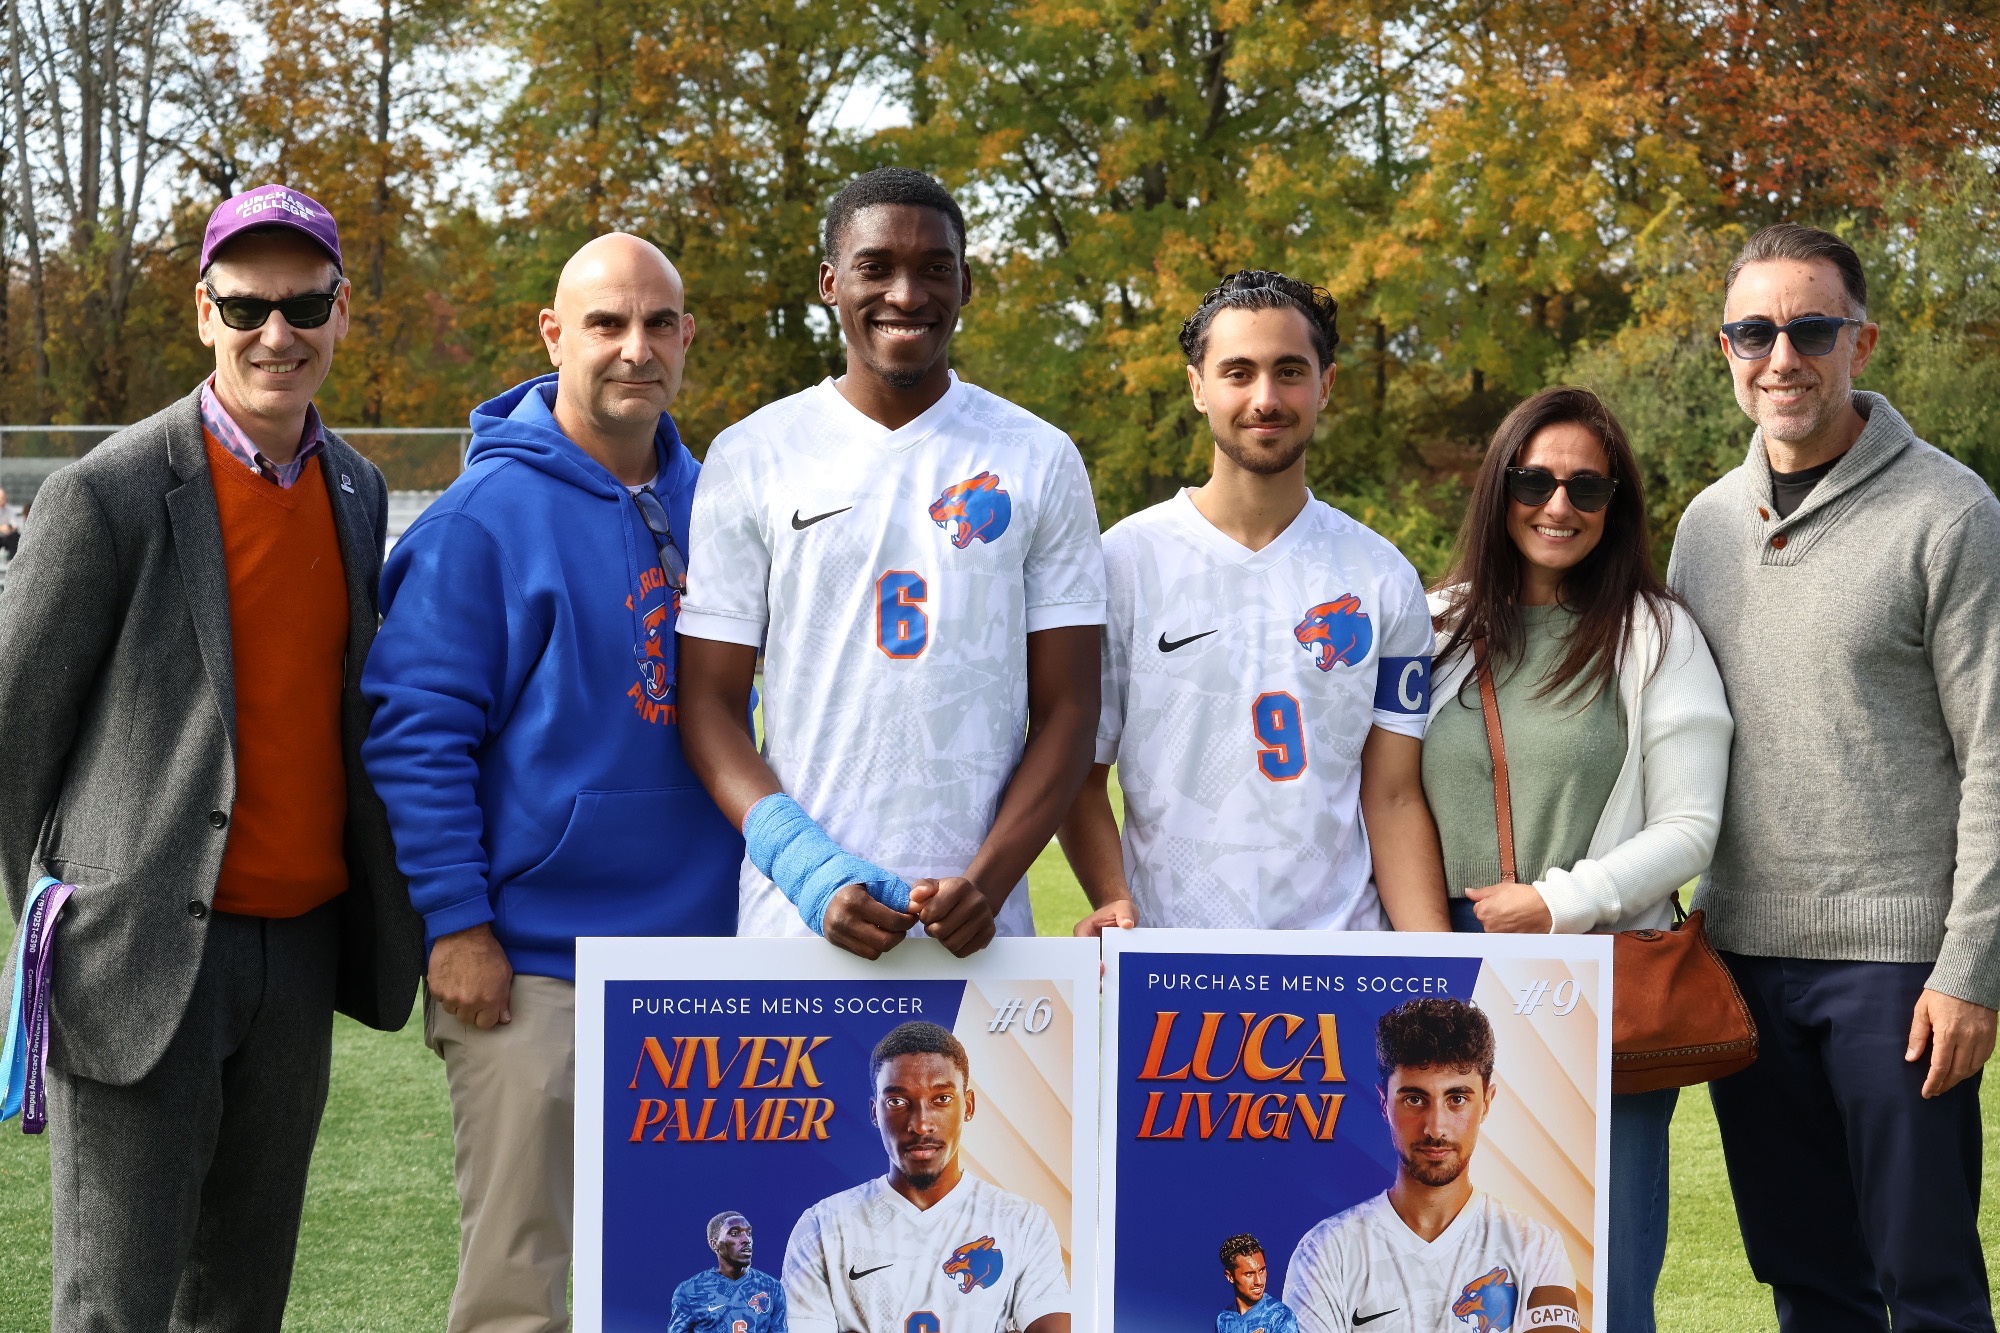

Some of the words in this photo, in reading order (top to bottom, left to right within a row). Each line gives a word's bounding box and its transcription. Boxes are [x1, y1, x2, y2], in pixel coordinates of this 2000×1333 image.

[236, 192, 315, 218] PURCHASE
[242, 200, 310, 222] COLLEGE
[876, 569, 928, 659] 6
[1398, 660, 1424, 711] C
[1252, 690, 1308, 782] 9
[1148, 974, 1270, 991] PURCHASE
[1282, 976, 1345, 993] MENS
[1356, 977, 1449, 994] SOCCER
[1512, 978, 1581, 1017] #9
[632, 997, 751, 1015] PURCHASE
[762, 997, 824, 1014] MENS
[834, 997, 924, 1014] SOCCER
[986, 996, 1053, 1033] #6
[628, 1036, 832, 1089] NIVEK
[1136, 1011, 1347, 1082] LUCA
[29, 1053, 39, 1090] Advocacy
[26, 1090, 36, 1120] Campus
[629, 1098, 835, 1142] PALMER
[1136, 1091, 1346, 1141] LIVIGNI
